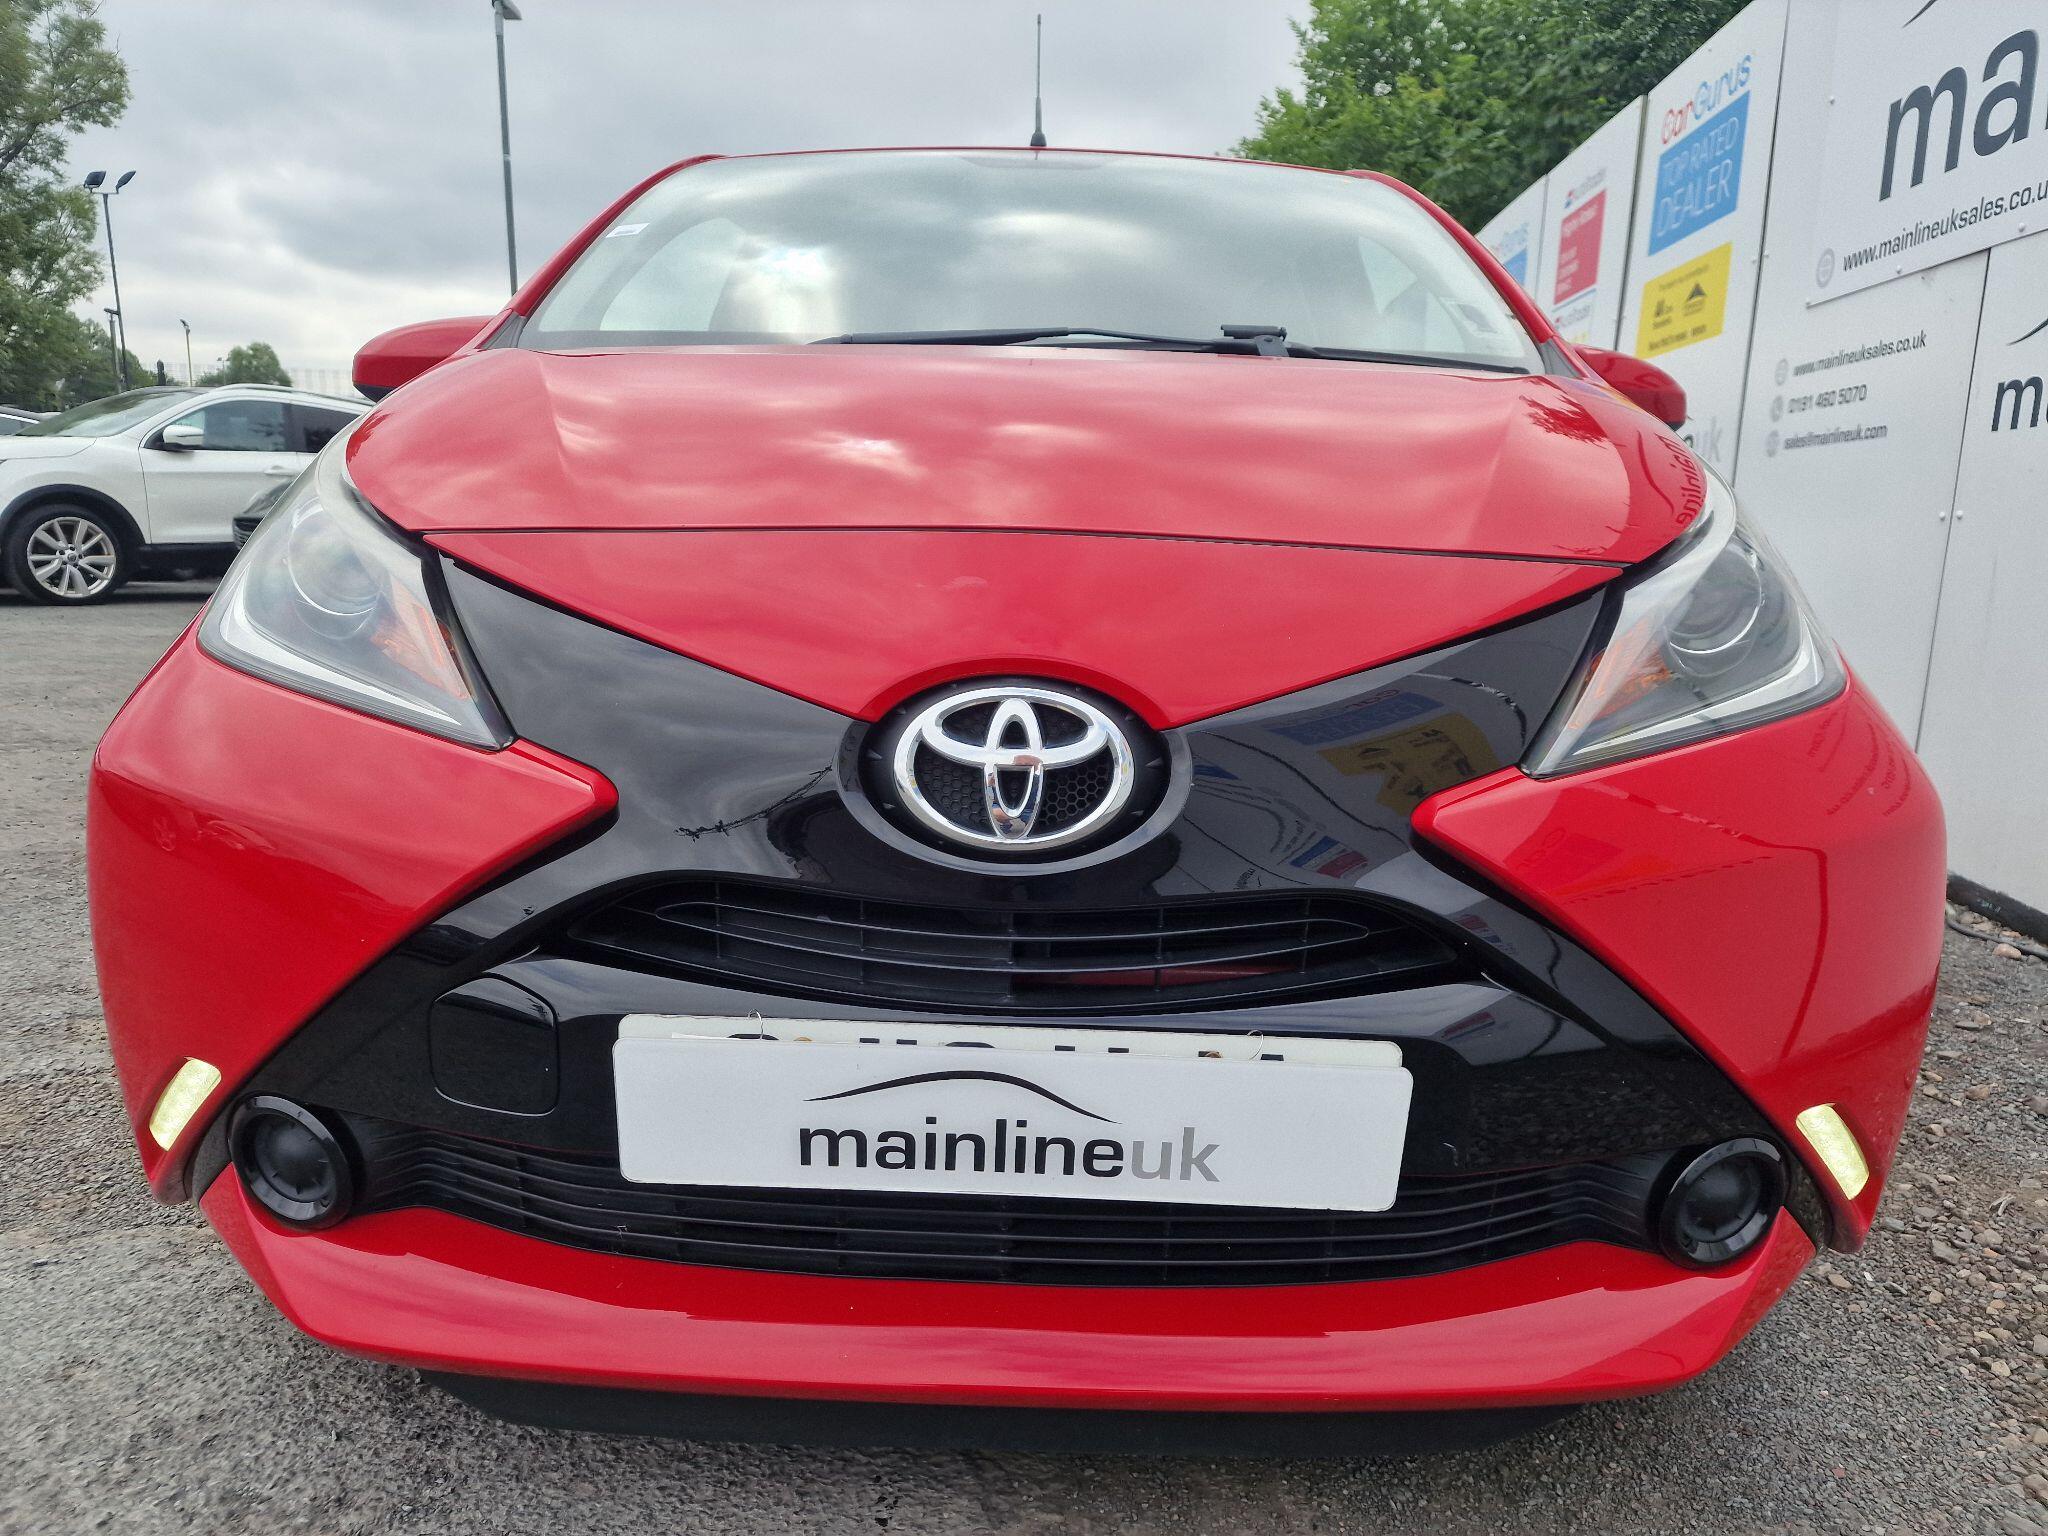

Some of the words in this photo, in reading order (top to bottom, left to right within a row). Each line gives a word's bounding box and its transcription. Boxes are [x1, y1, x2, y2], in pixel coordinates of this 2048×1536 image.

[1661, 54, 1751, 144] CarGurus
[1879, 29, 2048, 201] ma
[1690, 117, 1739, 170] RATED
[1656, 159, 1733, 236] DEALER
[1837, 384, 1867, 405] 5070
[800, 1116, 1221, 1183] mainlineuk
